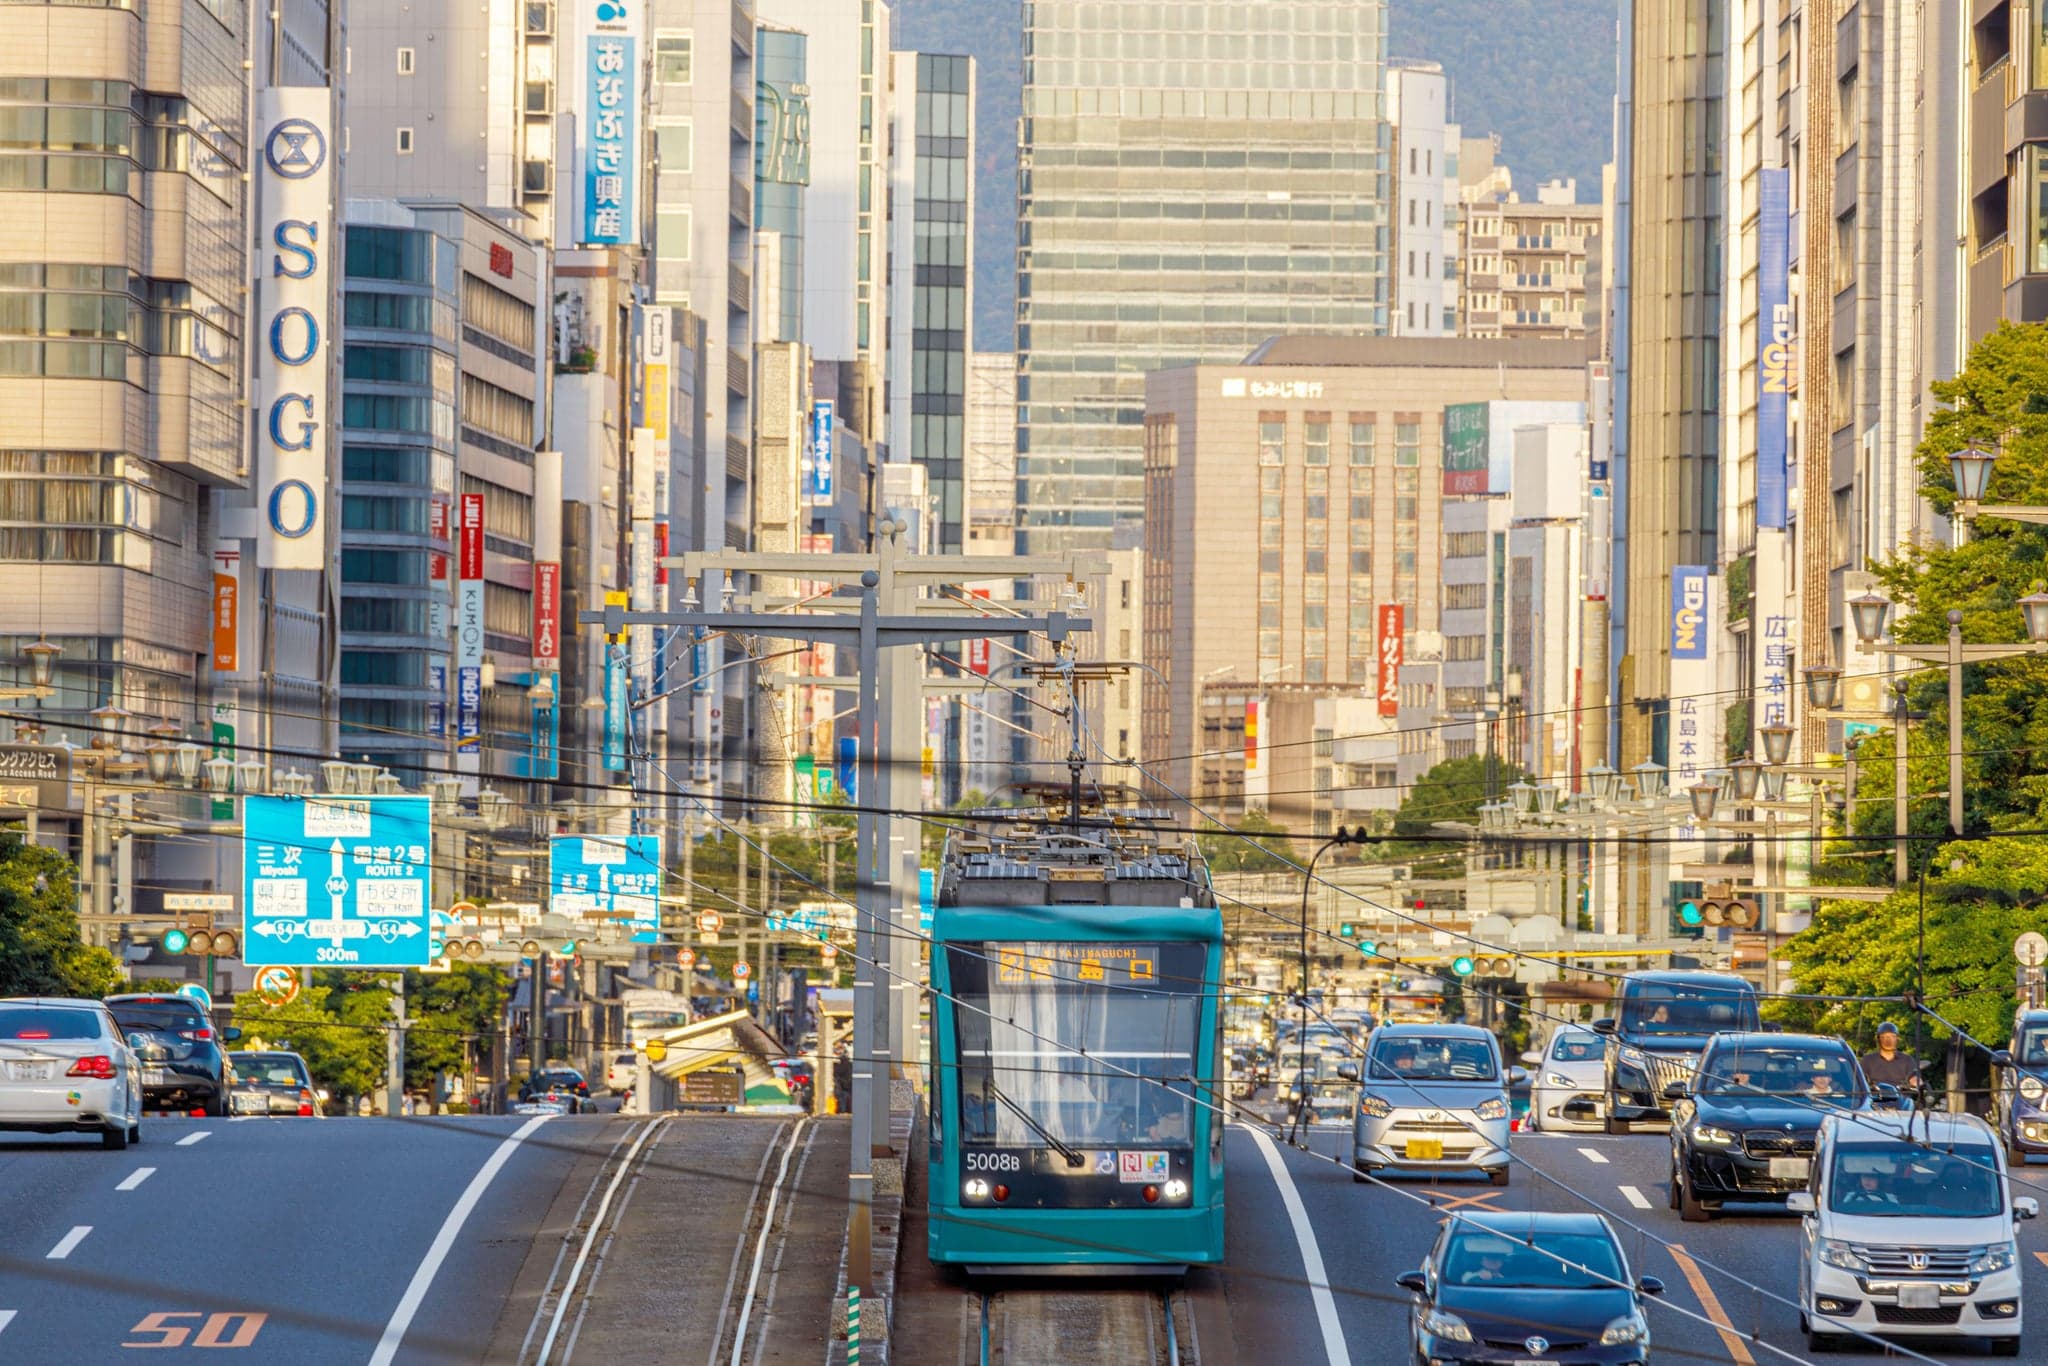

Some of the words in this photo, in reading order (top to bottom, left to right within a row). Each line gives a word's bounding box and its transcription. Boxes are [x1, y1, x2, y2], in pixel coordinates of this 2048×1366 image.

[594, 42, 624, 238] あなぶき興産
[269, 220, 320, 539] SOGO
[1675, 576, 1704, 649] EDION
[463, 589, 481, 657] KUMON
[540, 619, 553, 656] TAC
[1764, 615, 1786, 725] 広島本店
[1679, 698, 1697, 779] 広島本店
[257, 846, 302, 864] 三次
[353, 845, 426, 865] 国道2号
[365, 866, 402, 876] ROUTE
[406, 866, 414, 876] 2
[361, 883, 417, 901] 市役所
[367, 902, 385, 913] City
[277, 924, 292, 934] 54
[382, 924, 397, 934] 54
[316, 948, 359, 962] 300m
[966, 1153, 1020, 1171] 5008B
[120, 1311, 269, 1348] 50
